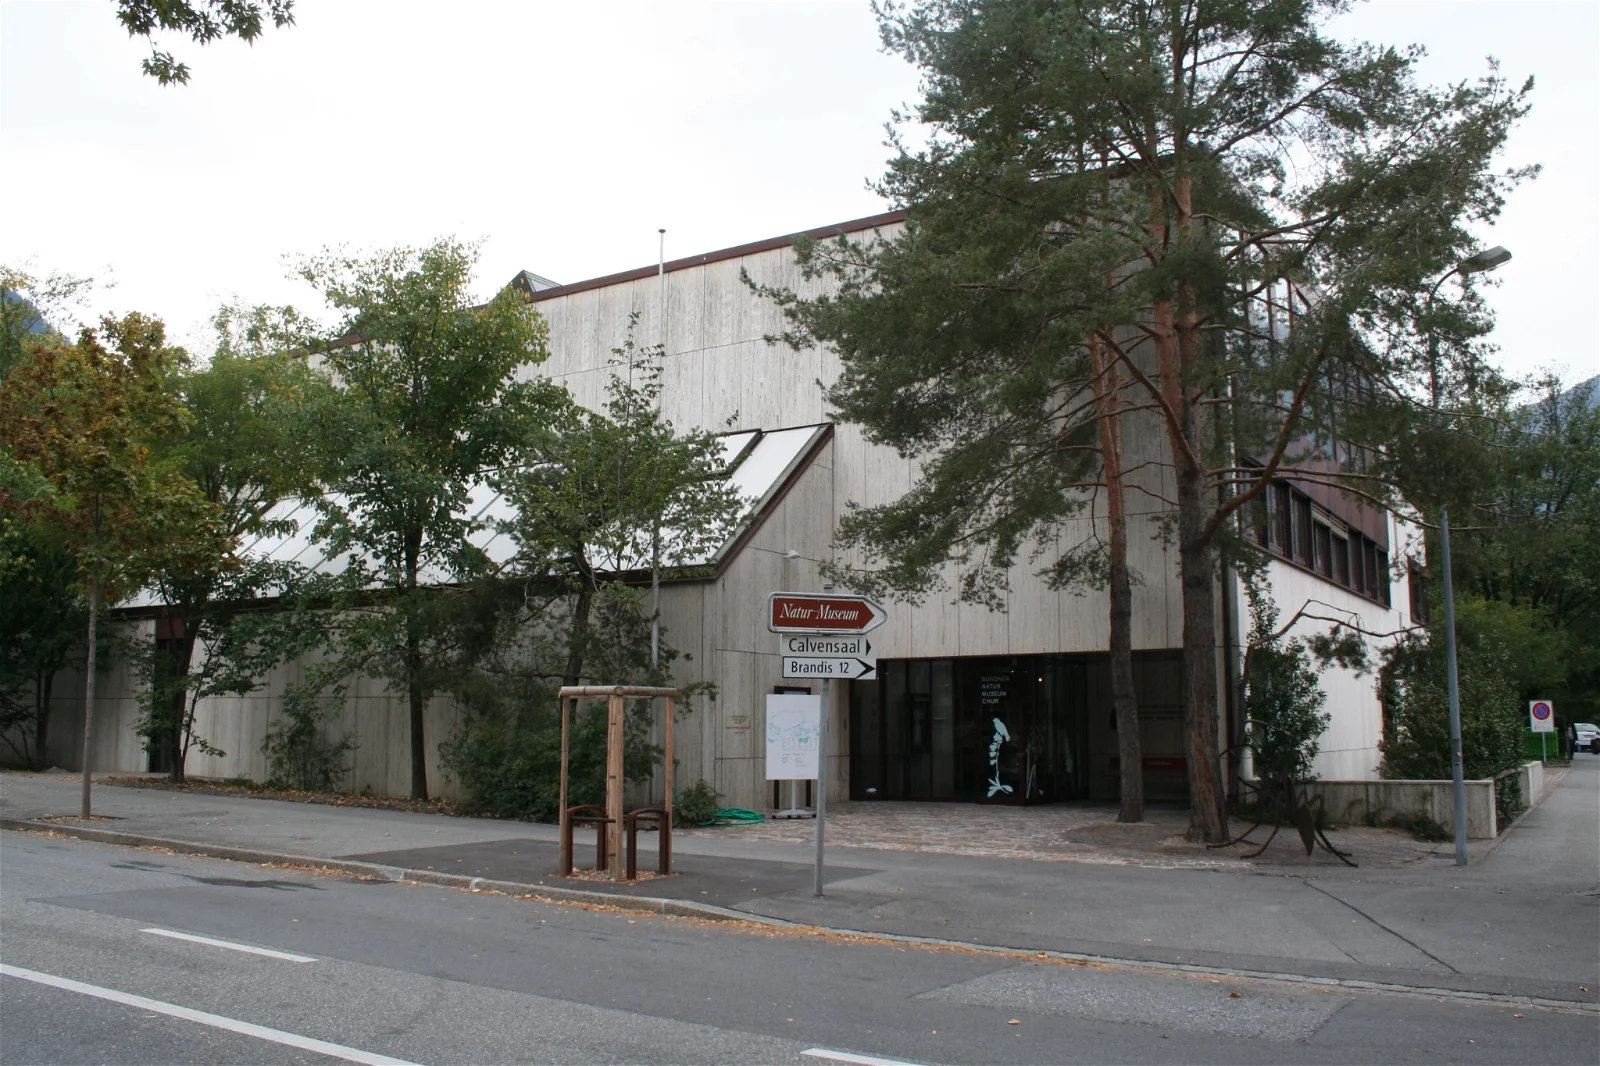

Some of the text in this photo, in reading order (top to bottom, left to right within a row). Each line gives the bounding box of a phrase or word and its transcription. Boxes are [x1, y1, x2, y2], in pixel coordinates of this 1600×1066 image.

[788, 637, 860, 653] Calvensaal
[791, 661, 849, 674] Brandis 12
